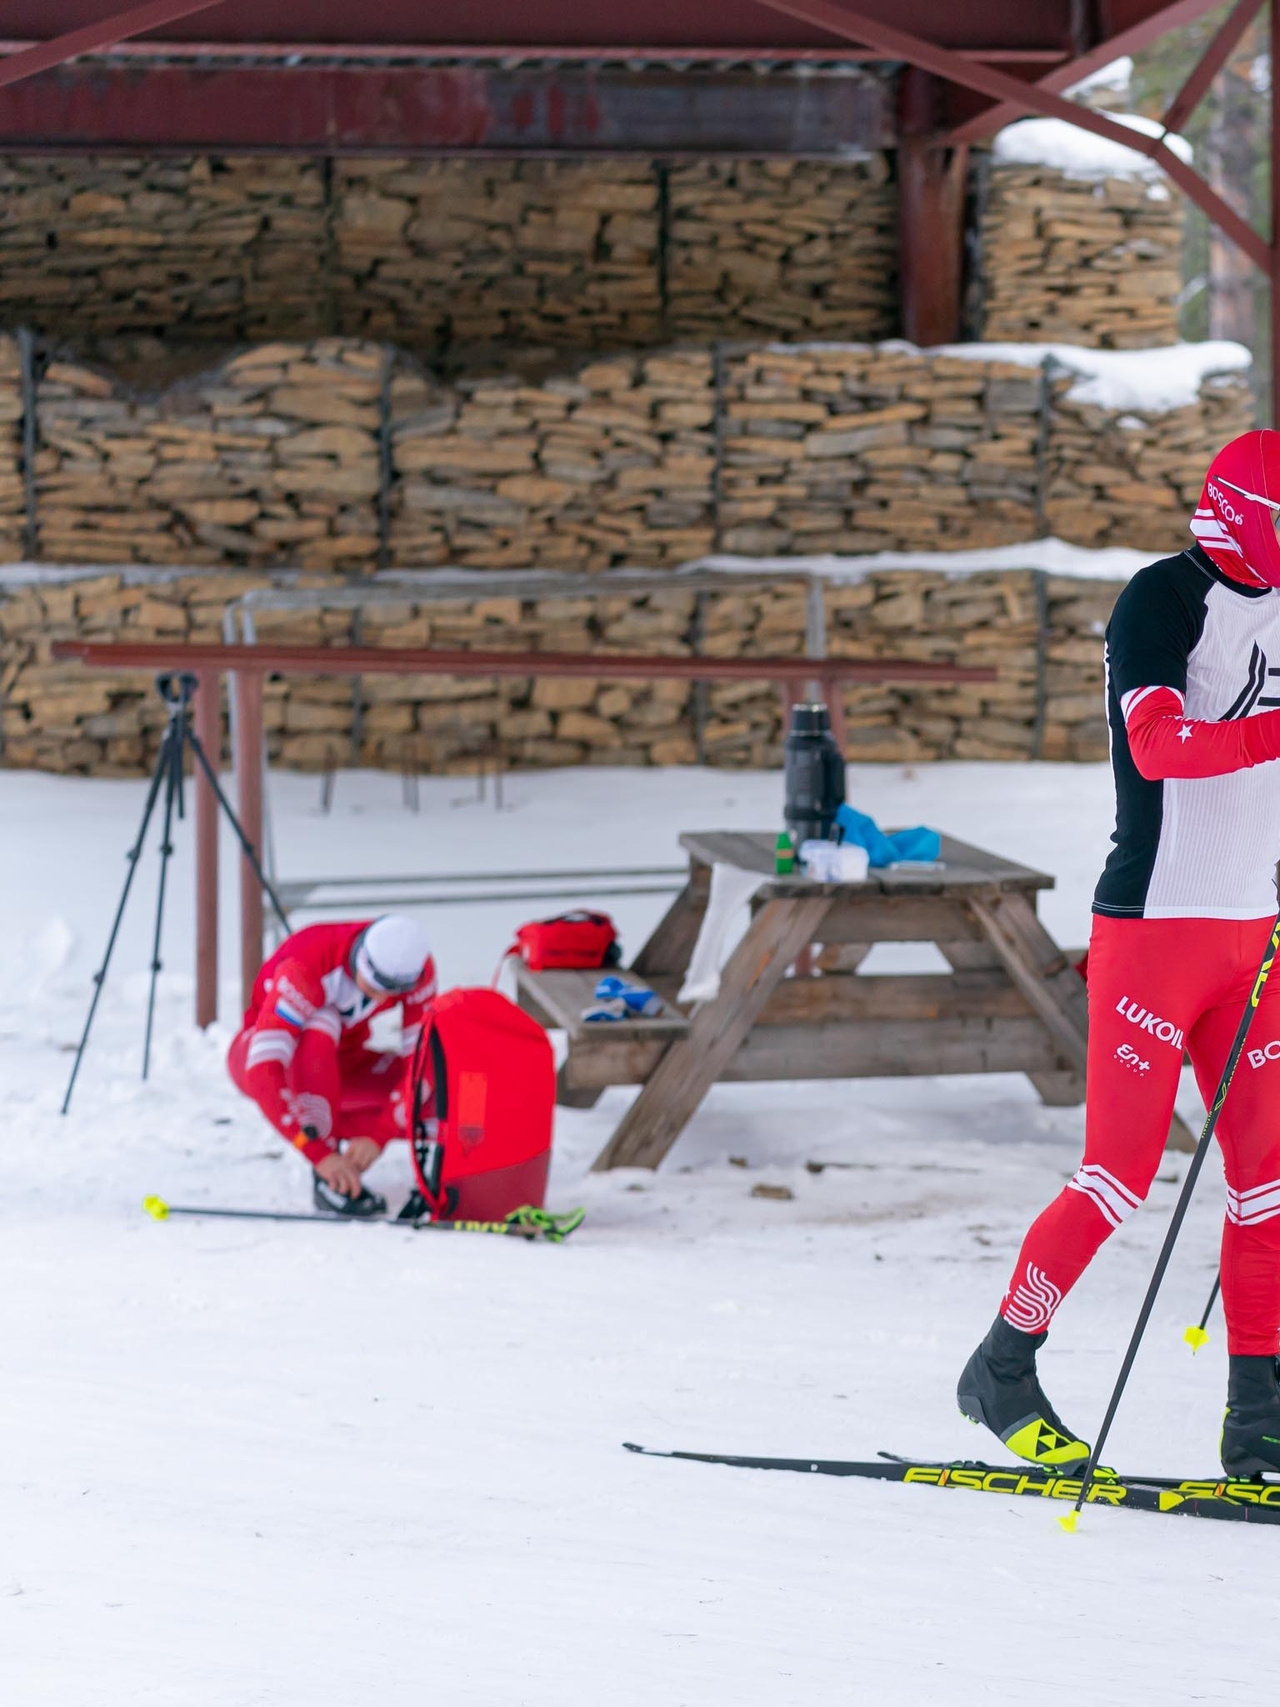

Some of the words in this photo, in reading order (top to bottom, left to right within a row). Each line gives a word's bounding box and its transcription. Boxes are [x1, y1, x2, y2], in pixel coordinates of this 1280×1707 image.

[1208, 483, 1234, 521] BOSCO
[1115, 996, 1184, 1050] LUKOIL
[903, 1467, 1127, 1505] FISCHER
